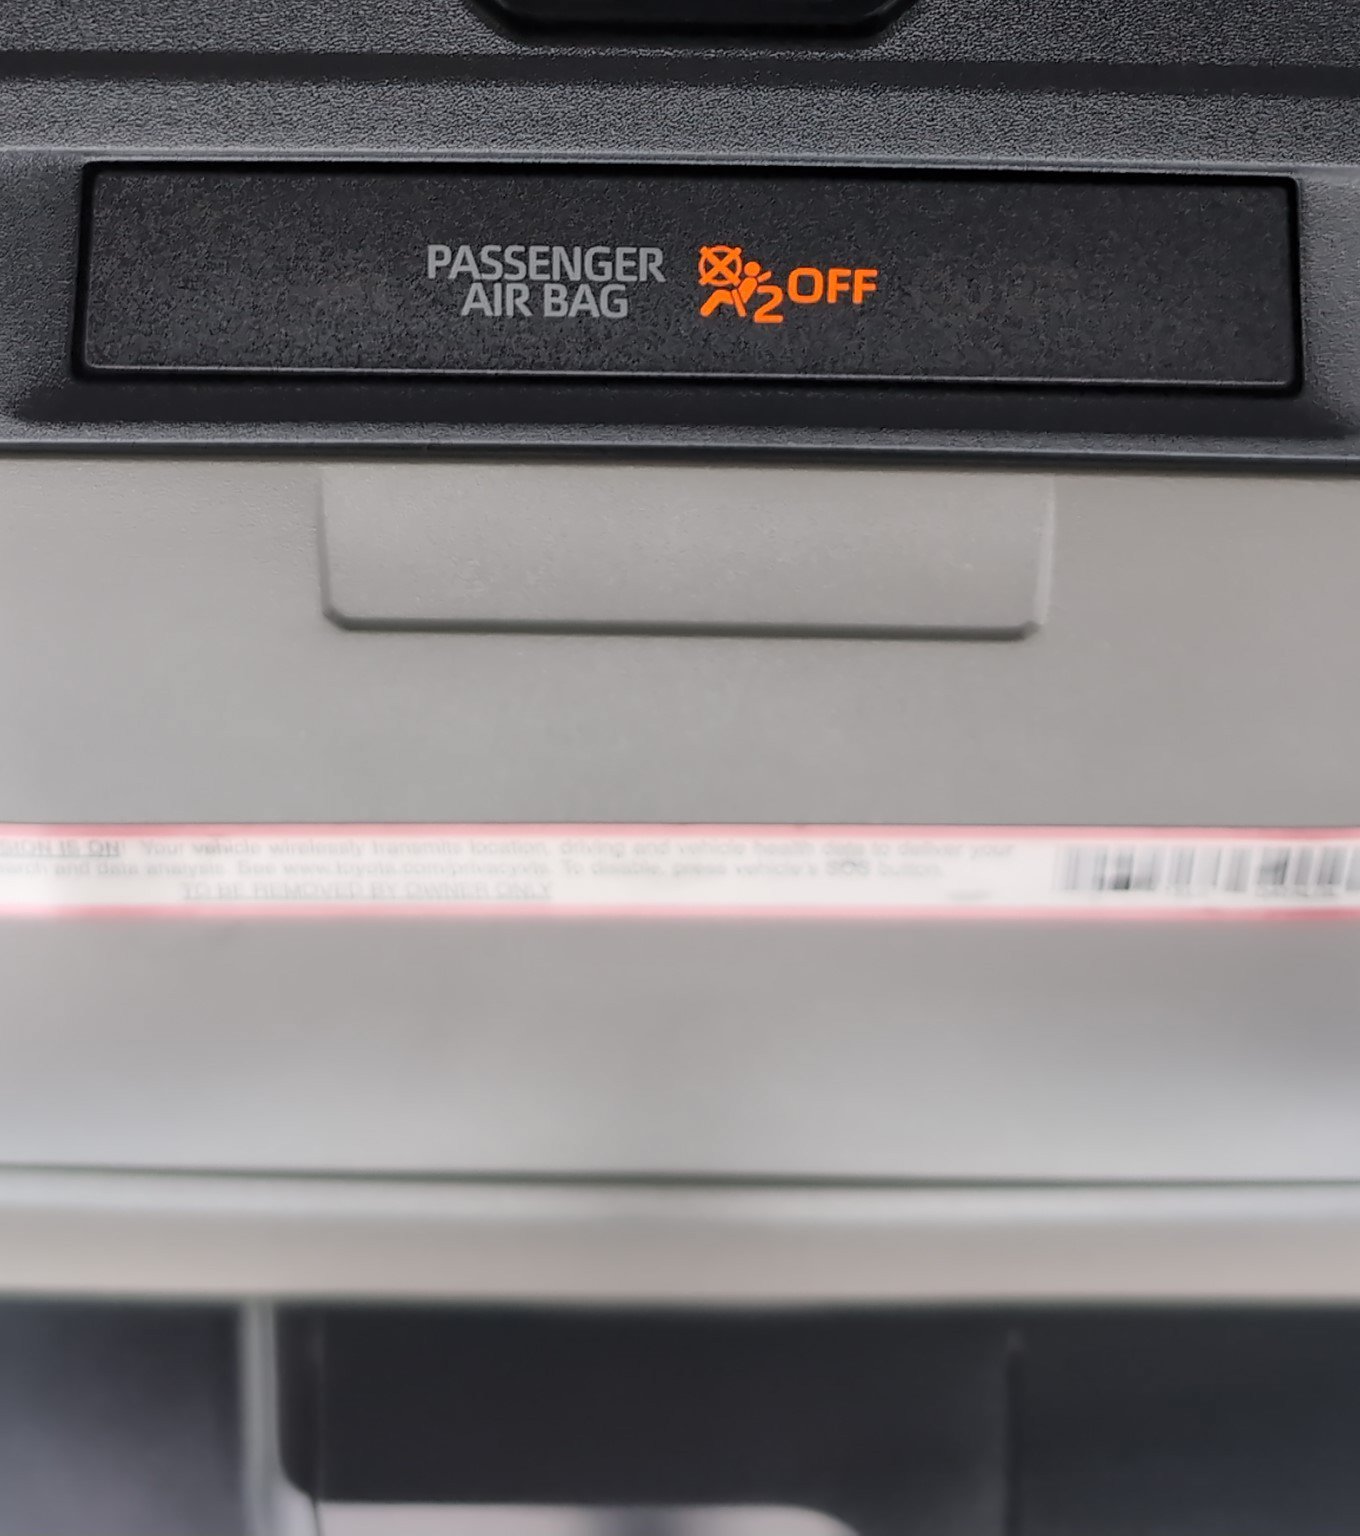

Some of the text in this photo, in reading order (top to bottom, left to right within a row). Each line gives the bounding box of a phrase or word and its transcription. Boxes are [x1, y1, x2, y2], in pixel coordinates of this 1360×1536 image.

[426, 244, 666, 283] PASSENGER
[787, 267, 879, 305] OFF
[460, 283, 629, 319] AIR BAG
[59, 840, 82, 856] IS
[140, 841, 183, 855] Your
[192, 840, 261, 855] vehicle
[269, 841, 363, 858] wirelessly
[372, 841, 463, 855] transmits
[559, 841, 625, 859] driving
[632, 841, 670, 855] and
[677, 841, 746, 855] vehicle
[754, 841, 814, 855] health
[822, 842, 865, 855] data
[871, 842, 891, 855] to
[897, 842, 963, 856] deliver
[969, 845, 1015, 861] your
[54, 862, 89, 876] and
[97, 862, 138, 875] data
[237, 861, 276, 875] See
[559, 860, 584, 875] To
[671, 864, 726, 879] press
[825, 860, 871, 877] SOS
[178, 882, 554, 900] TO BE REMOVED BY OWNER ONLY
